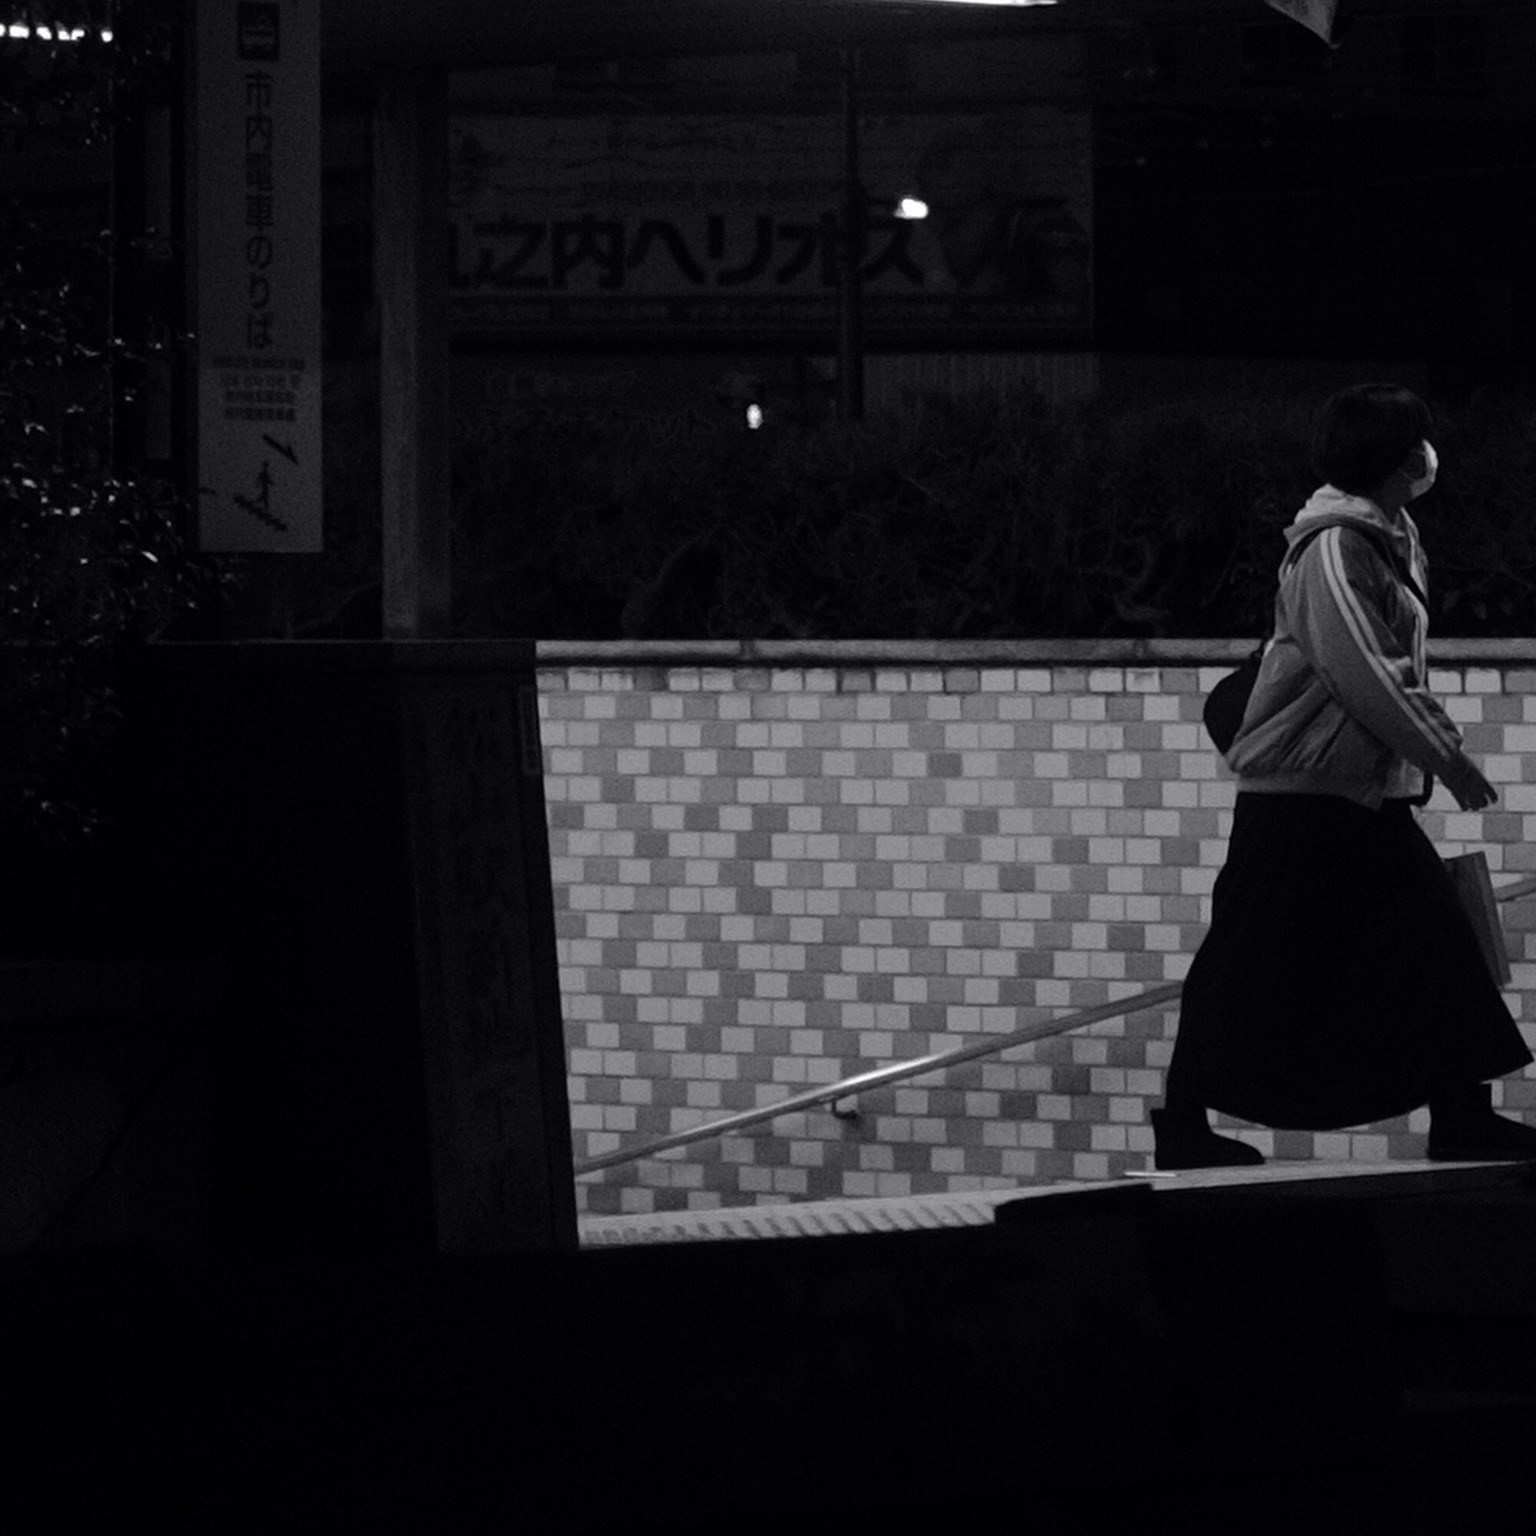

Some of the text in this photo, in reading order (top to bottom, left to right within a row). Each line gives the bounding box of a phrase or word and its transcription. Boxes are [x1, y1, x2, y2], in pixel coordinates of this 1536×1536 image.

[244, 69, 276, 350] 市内電車のりば
